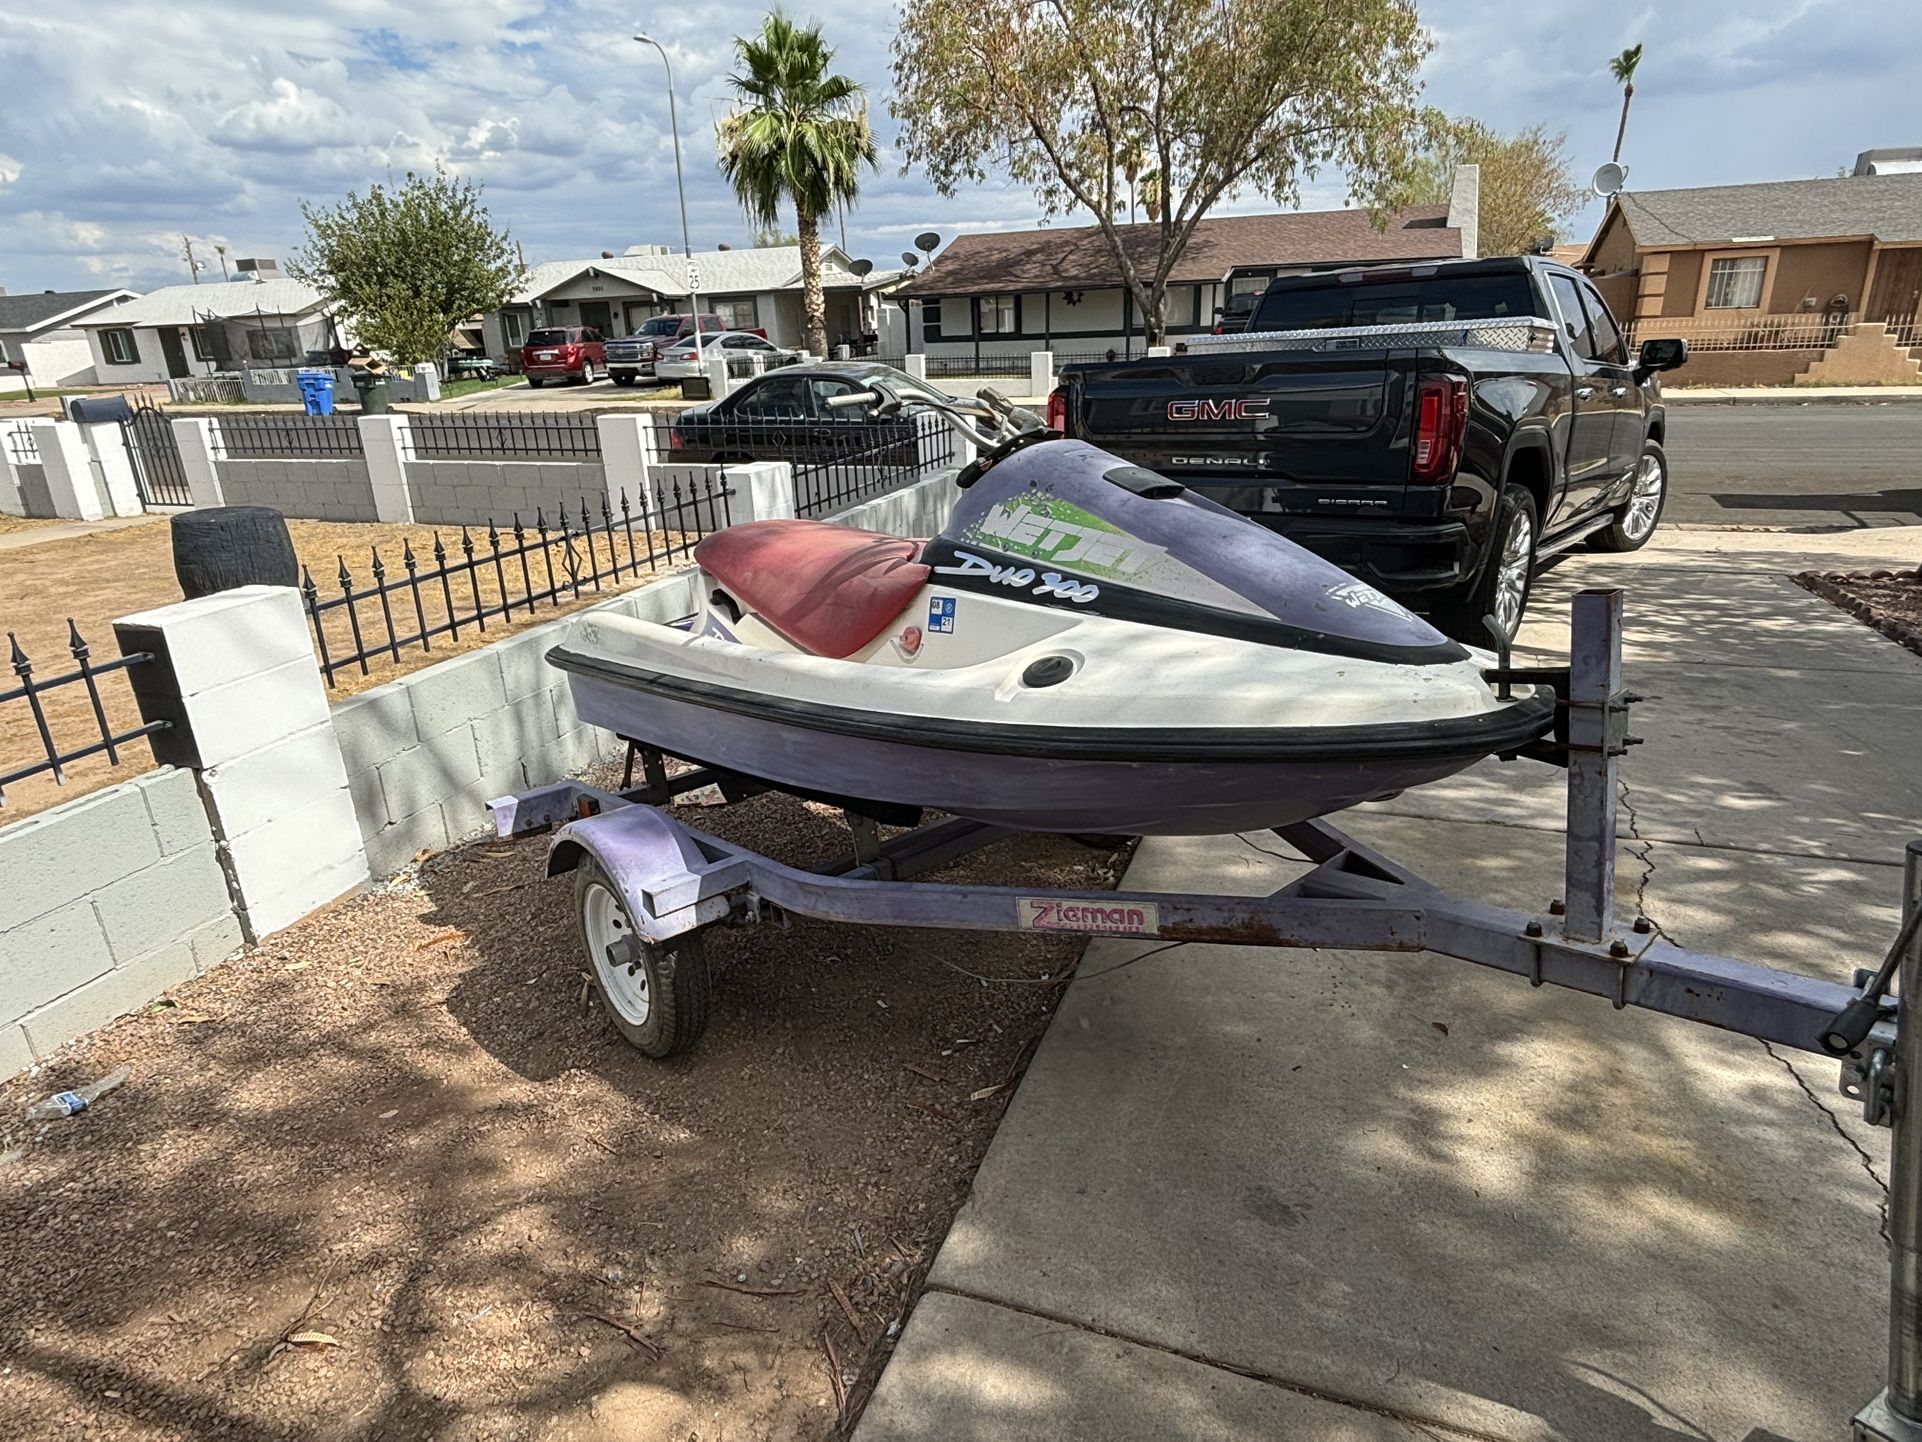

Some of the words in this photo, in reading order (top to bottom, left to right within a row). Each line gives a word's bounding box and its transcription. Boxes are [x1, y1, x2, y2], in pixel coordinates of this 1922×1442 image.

[689, 275, 700, 289] 25
[1167, 398, 1271, 421] GMC
[1171, 456, 1266, 466] DENALI
[1318, 498, 1388, 506] SIERRA
[942, 617, 951, 626] 21
[1030, 899, 1145, 929] Zieman
